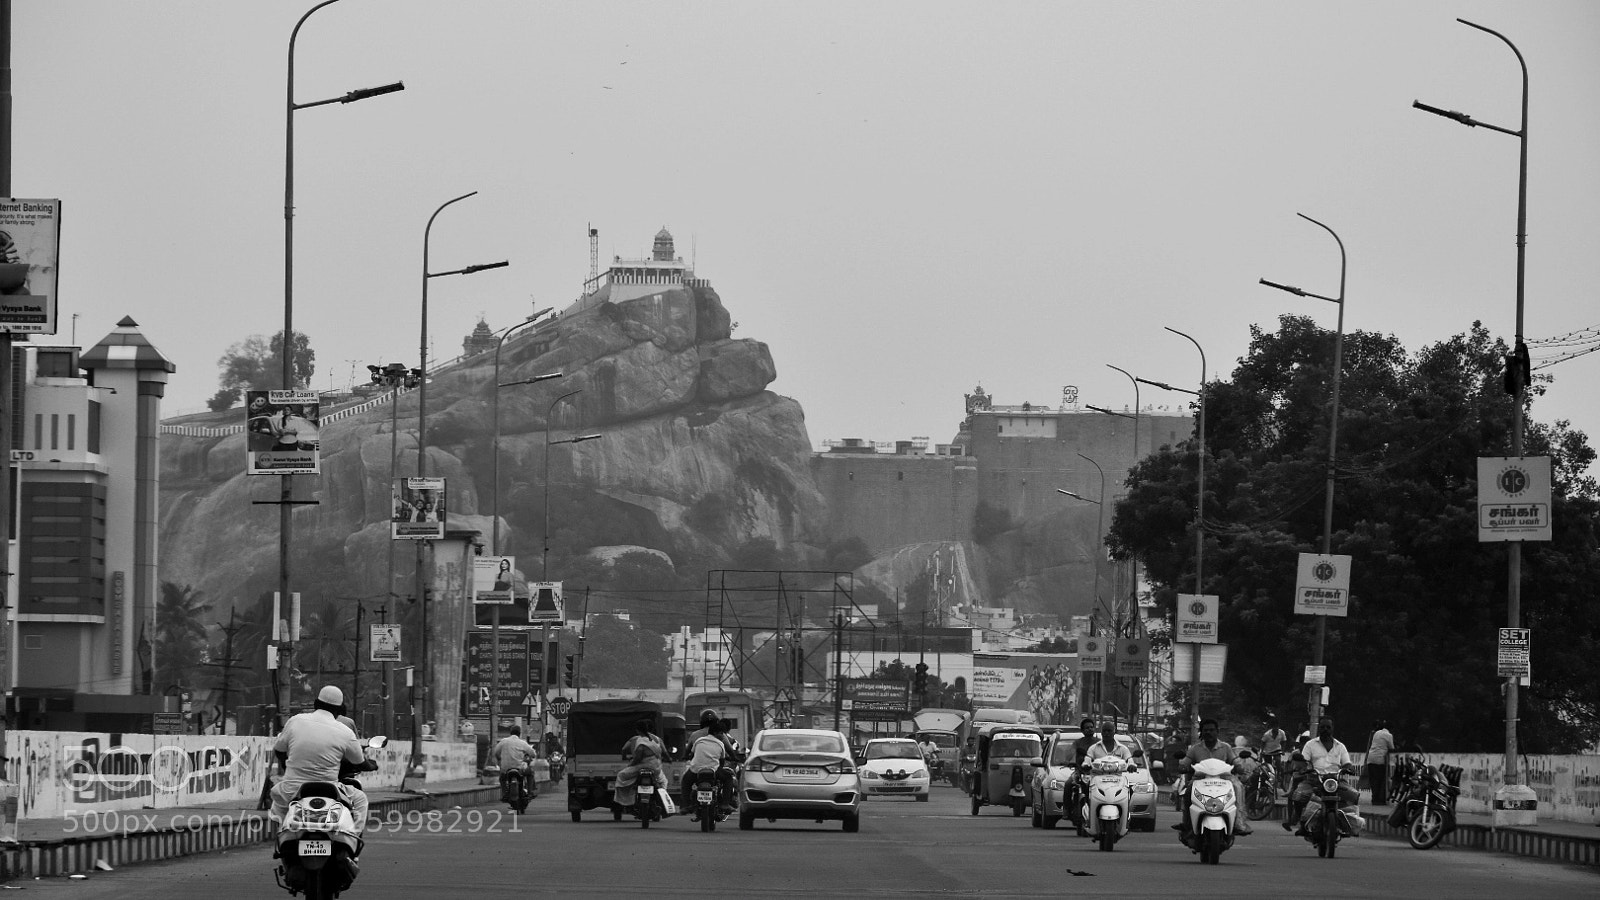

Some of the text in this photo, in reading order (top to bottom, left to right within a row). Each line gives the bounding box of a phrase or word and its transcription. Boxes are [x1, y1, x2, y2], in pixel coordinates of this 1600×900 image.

[23, 203, 53, 214] Banking
[12, 451, 34, 461] LTD
[1489, 504, 1540, 518] சங்கர்
[1500, 629, 1529, 640] SET
[550, 702, 571, 715] STOP
